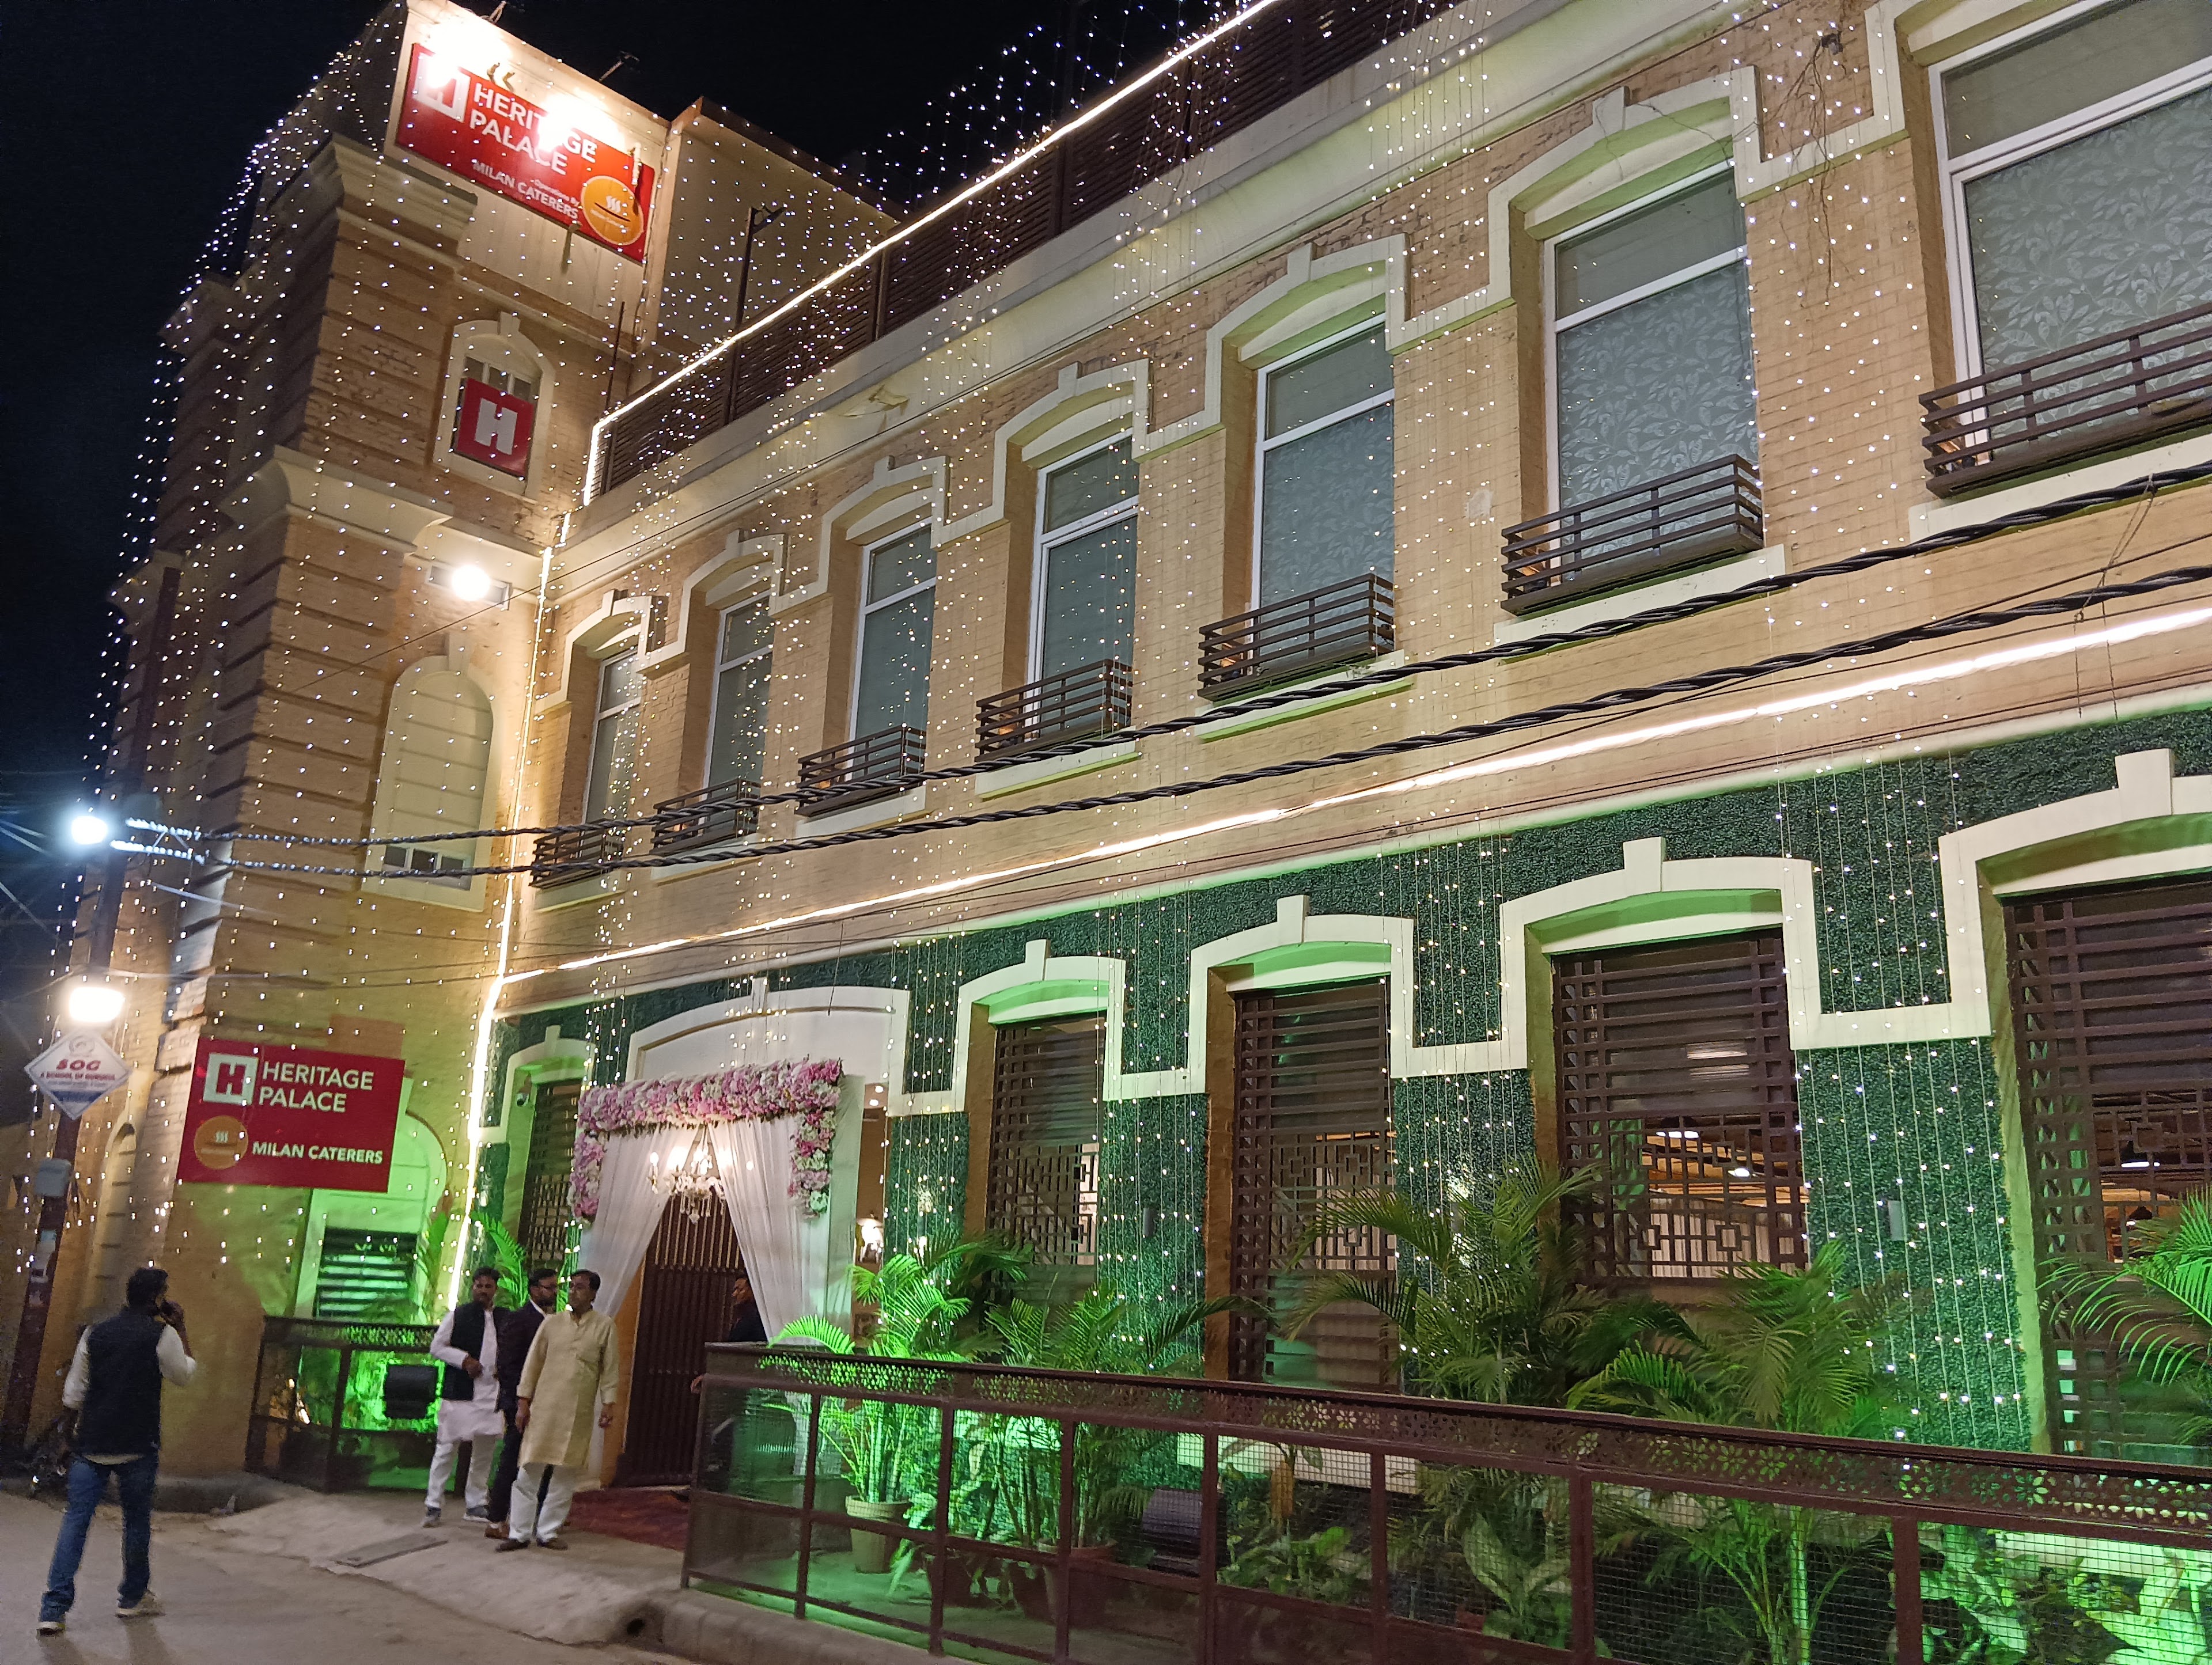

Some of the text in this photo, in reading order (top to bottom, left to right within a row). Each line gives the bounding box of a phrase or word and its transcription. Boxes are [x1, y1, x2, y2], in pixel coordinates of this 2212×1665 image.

[474, 82, 598, 163] HERITGE
[473, 161, 578, 219] MILAN CATERERS
[474, 398, 517, 455] H
[262, 1061, 374, 1091] HERITAGE
[259, 1086, 347, 1113] PALACE
[252, 1141, 304, 1159] MILAN
[308, 1146, 383, 1165] CATERERS
